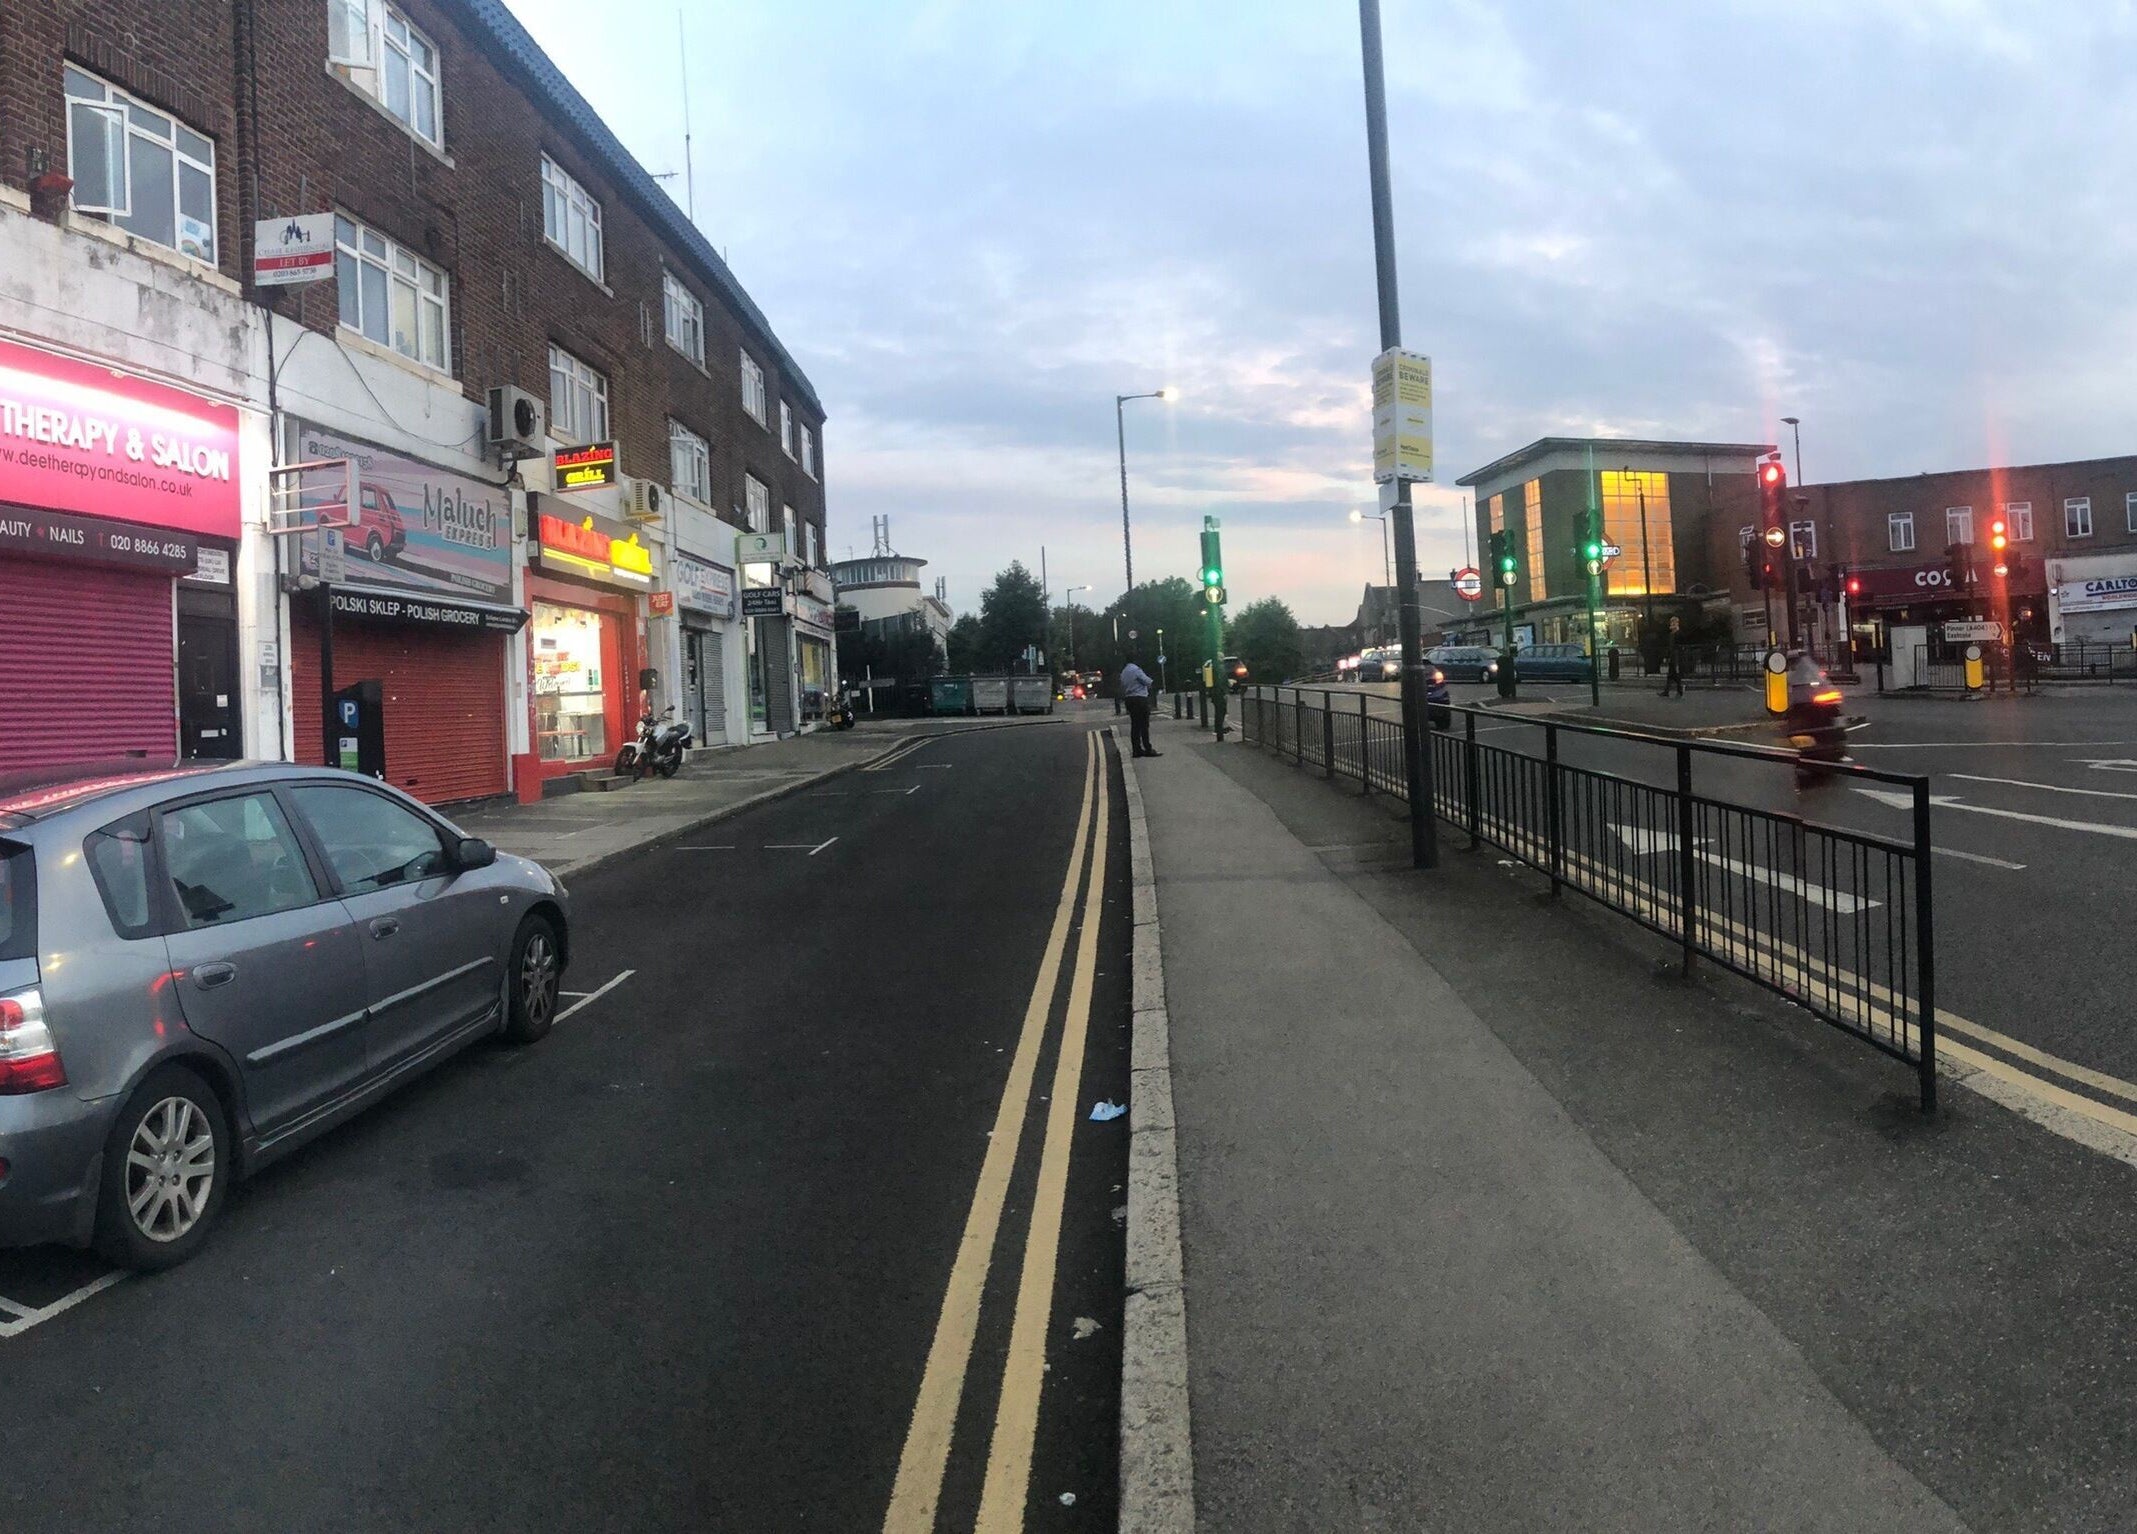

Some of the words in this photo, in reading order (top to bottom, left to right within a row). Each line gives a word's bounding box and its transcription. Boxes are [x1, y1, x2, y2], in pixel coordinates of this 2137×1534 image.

[280, 258, 296, 267] LET
[298, 257, 310, 266] BY
[1399, 371, 1429, 386] BEWARE
[0, 401, 118, 455] THERAPY
[126, 428, 145, 461] &
[151, 433, 229, 482] SALON
[556, 447, 613, 465] BLAZING
[566, 468, 605, 483] GRILL
[424, 482, 497, 548] Maluch
[49, 526, 85, 545] NAILS
[110, 534, 131, 551] 020
[134, 538, 159, 555] 8866
[162, 543, 187, 559] 4285
[445, 525, 492, 549] EXPRESS
[652, 593, 669, 602] JUST
[743, 591, 760, 599] GOLF
[762, 590, 780, 598] CARS
[330, 595, 367, 613] POLSKI
[369, 600, 400, 616] SKLEP
[407, 604, 440, 621] POLISH
[441, 609, 479, 625] GROCERY
[344, 702, 355, 723] P
